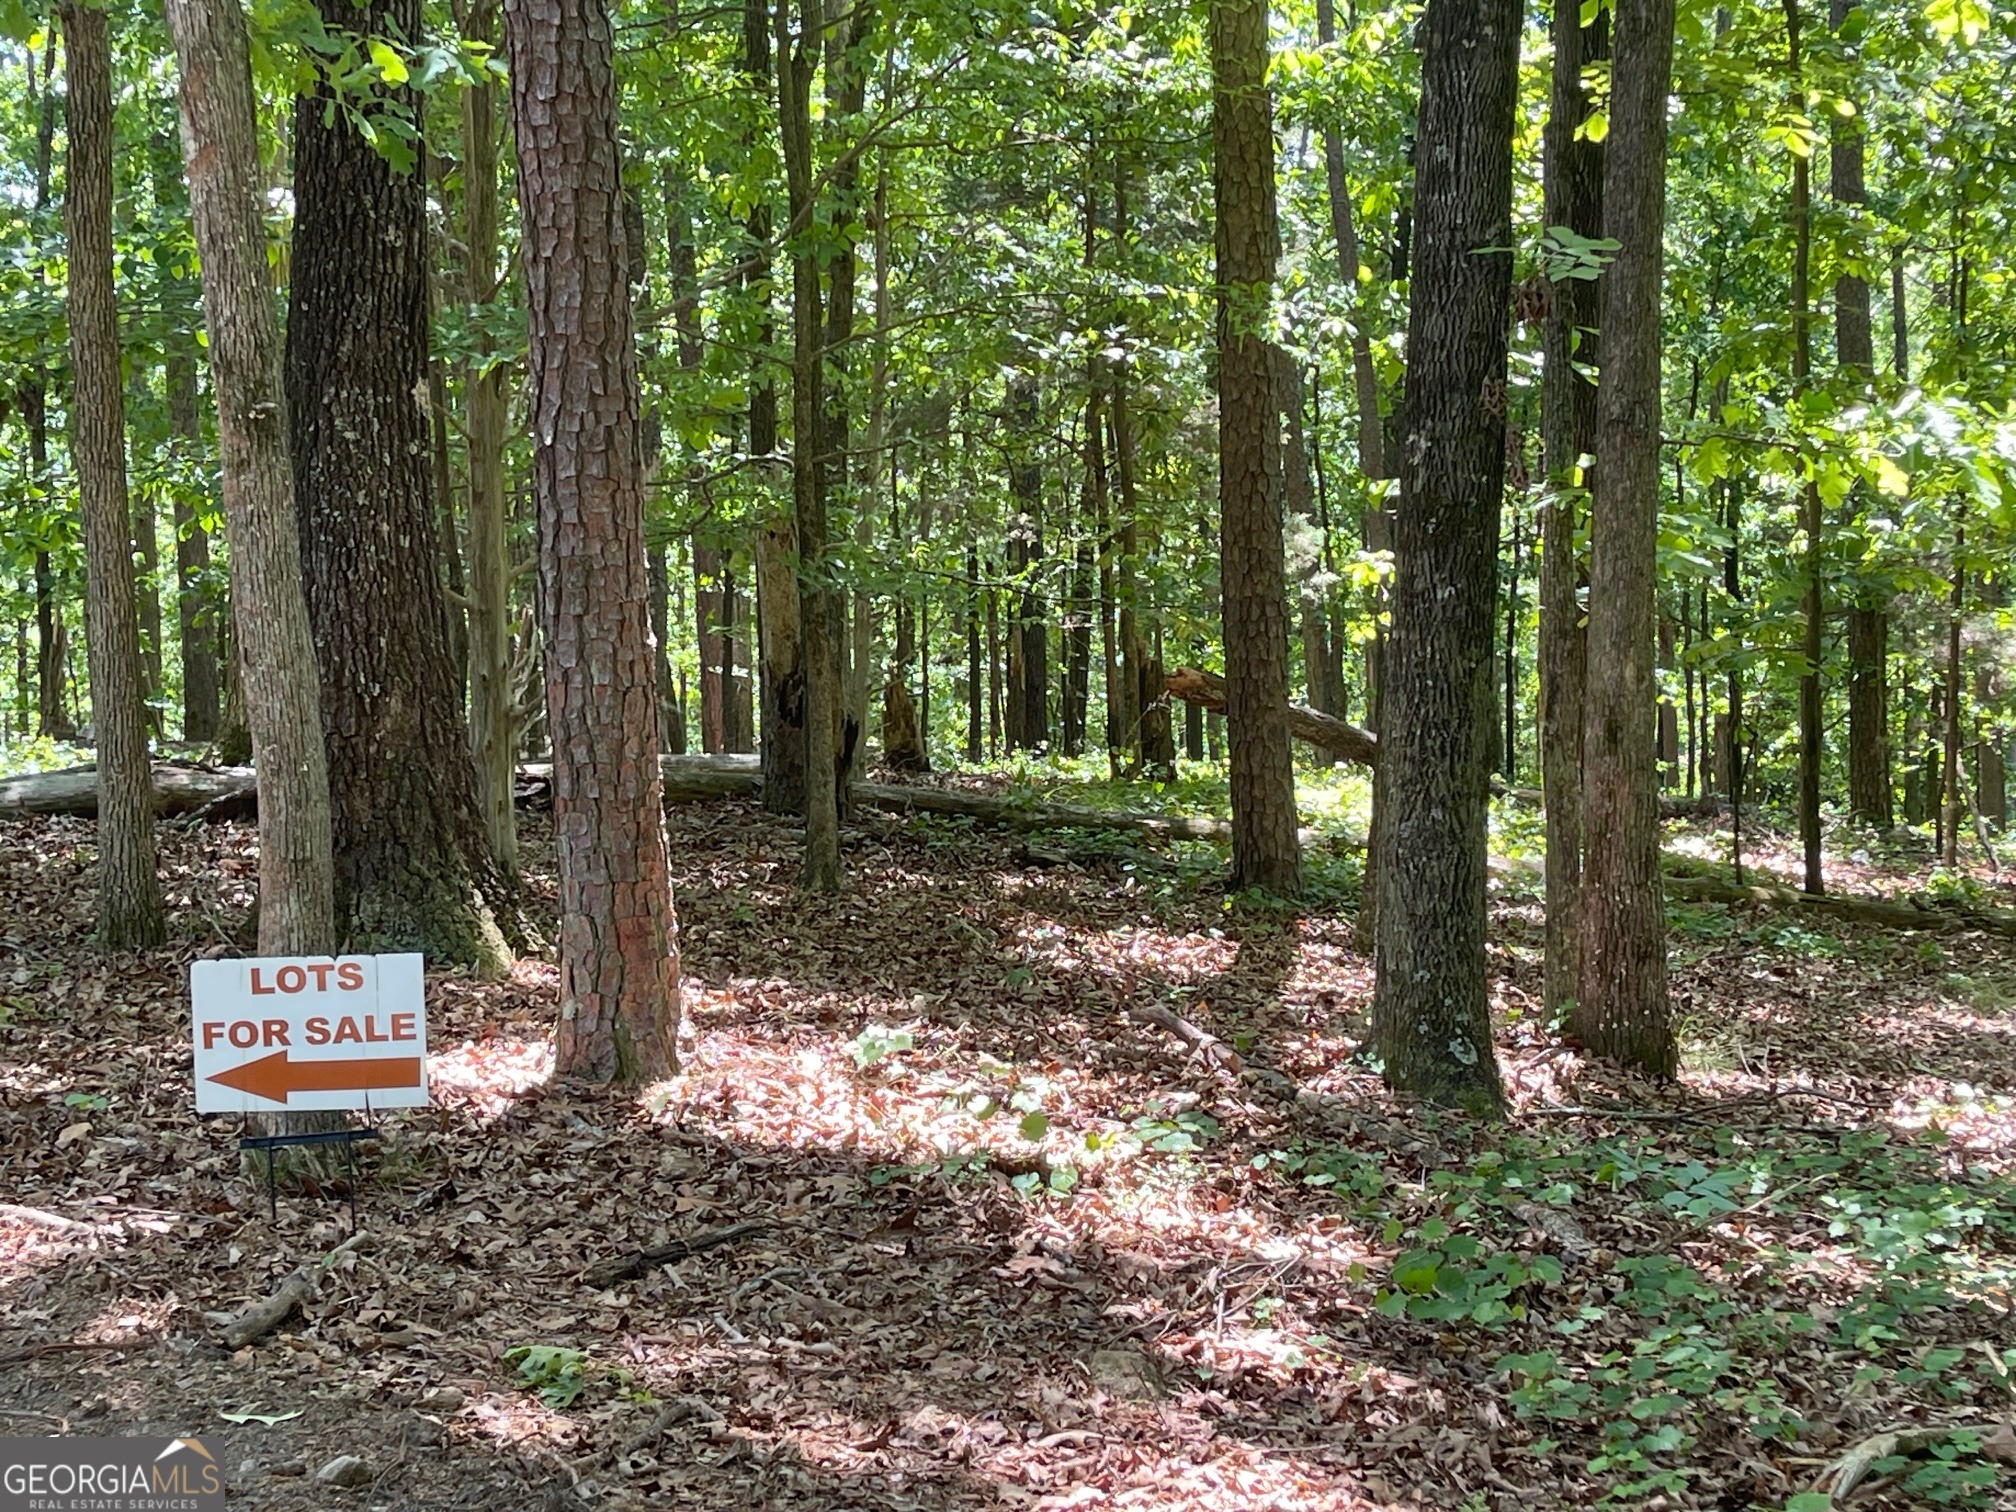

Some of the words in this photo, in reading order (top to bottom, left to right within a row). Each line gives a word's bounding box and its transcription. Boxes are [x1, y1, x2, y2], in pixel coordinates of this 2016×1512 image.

[250, 962, 364, 995] LOTS
[202, 1019, 292, 1049] FOR
[305, 1012, 417, 1045] SALE
